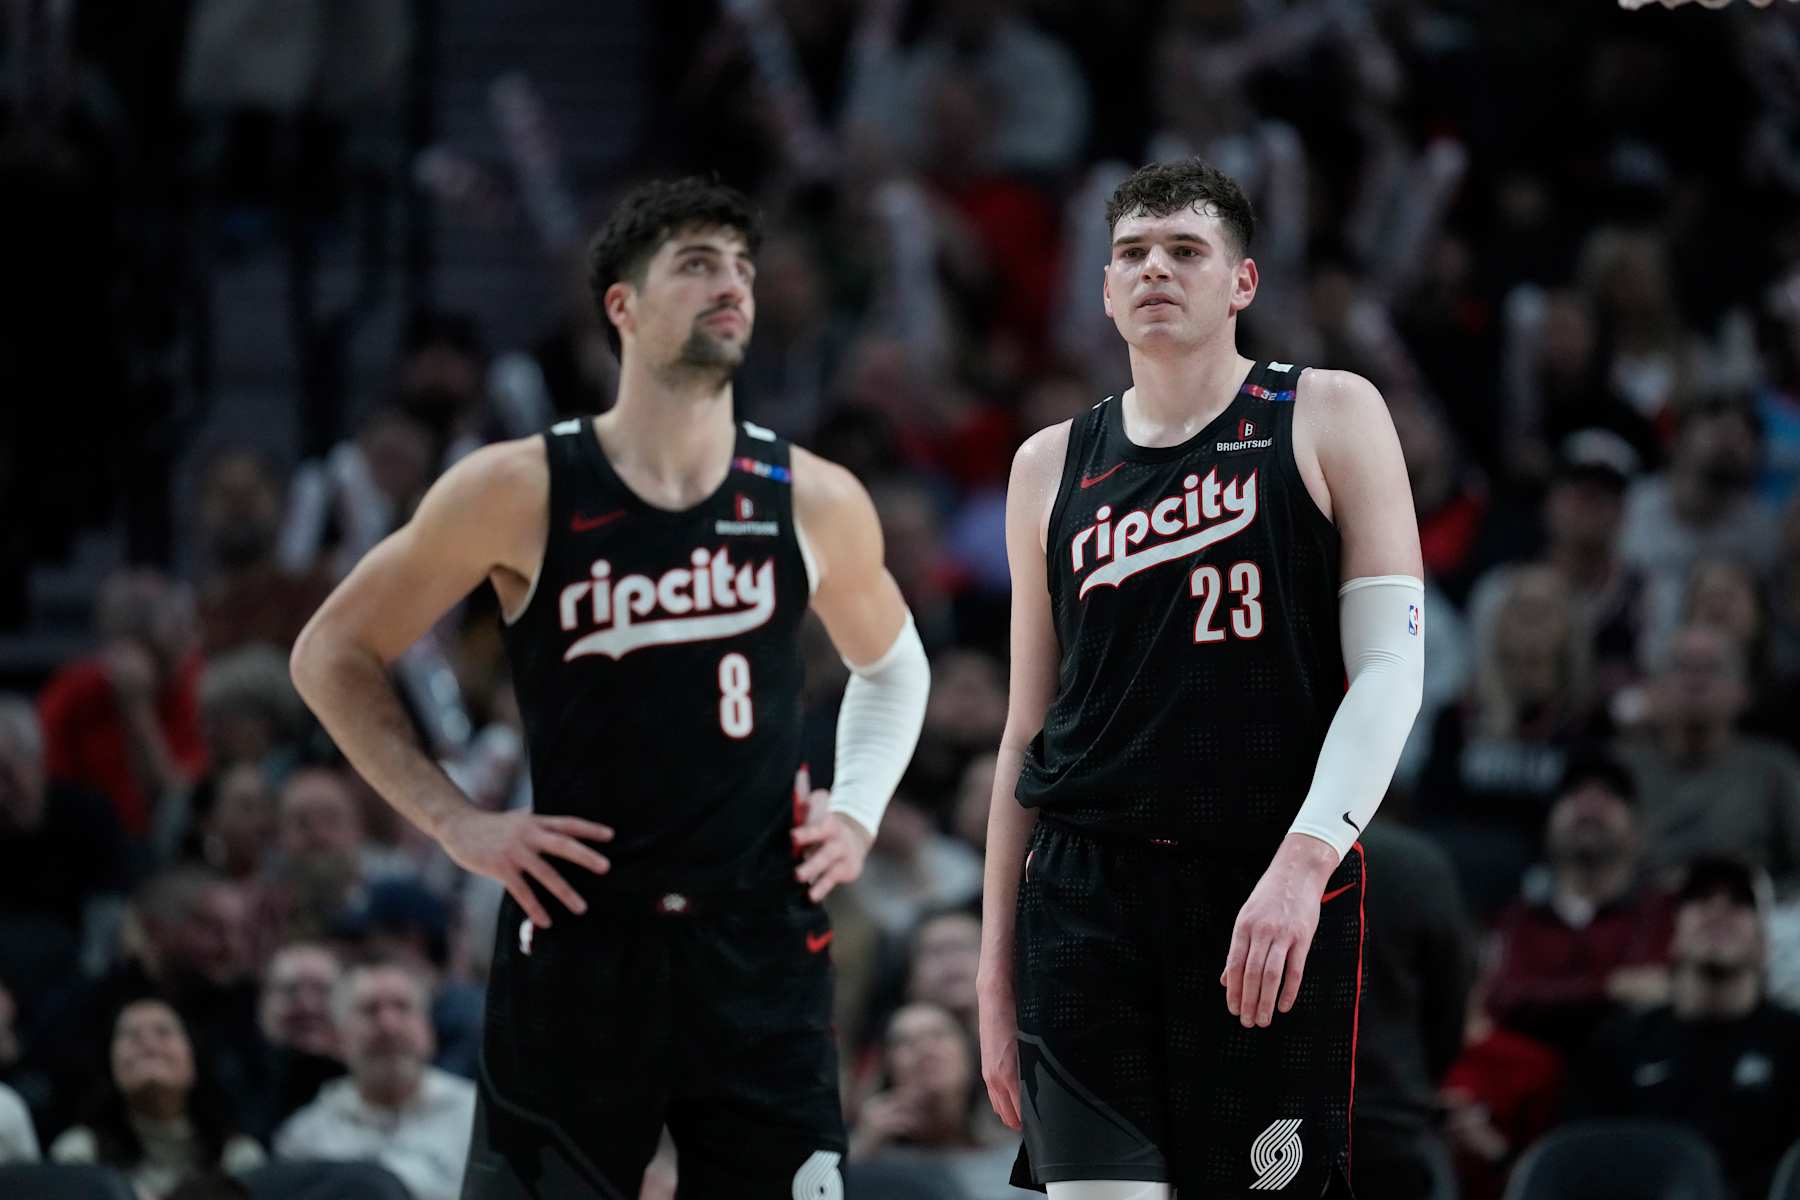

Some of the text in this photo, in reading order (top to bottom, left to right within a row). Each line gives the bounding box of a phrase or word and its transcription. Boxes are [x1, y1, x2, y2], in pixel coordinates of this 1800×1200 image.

[1216, 437, 1273, 452] BRIGHTSIDE
[1070, 465, 1260, 600] ripcity
[559, 545, 776, 663] ripcity
[1190, 560, 1265, 644] 23
[717, 651, 755, 741] 8
